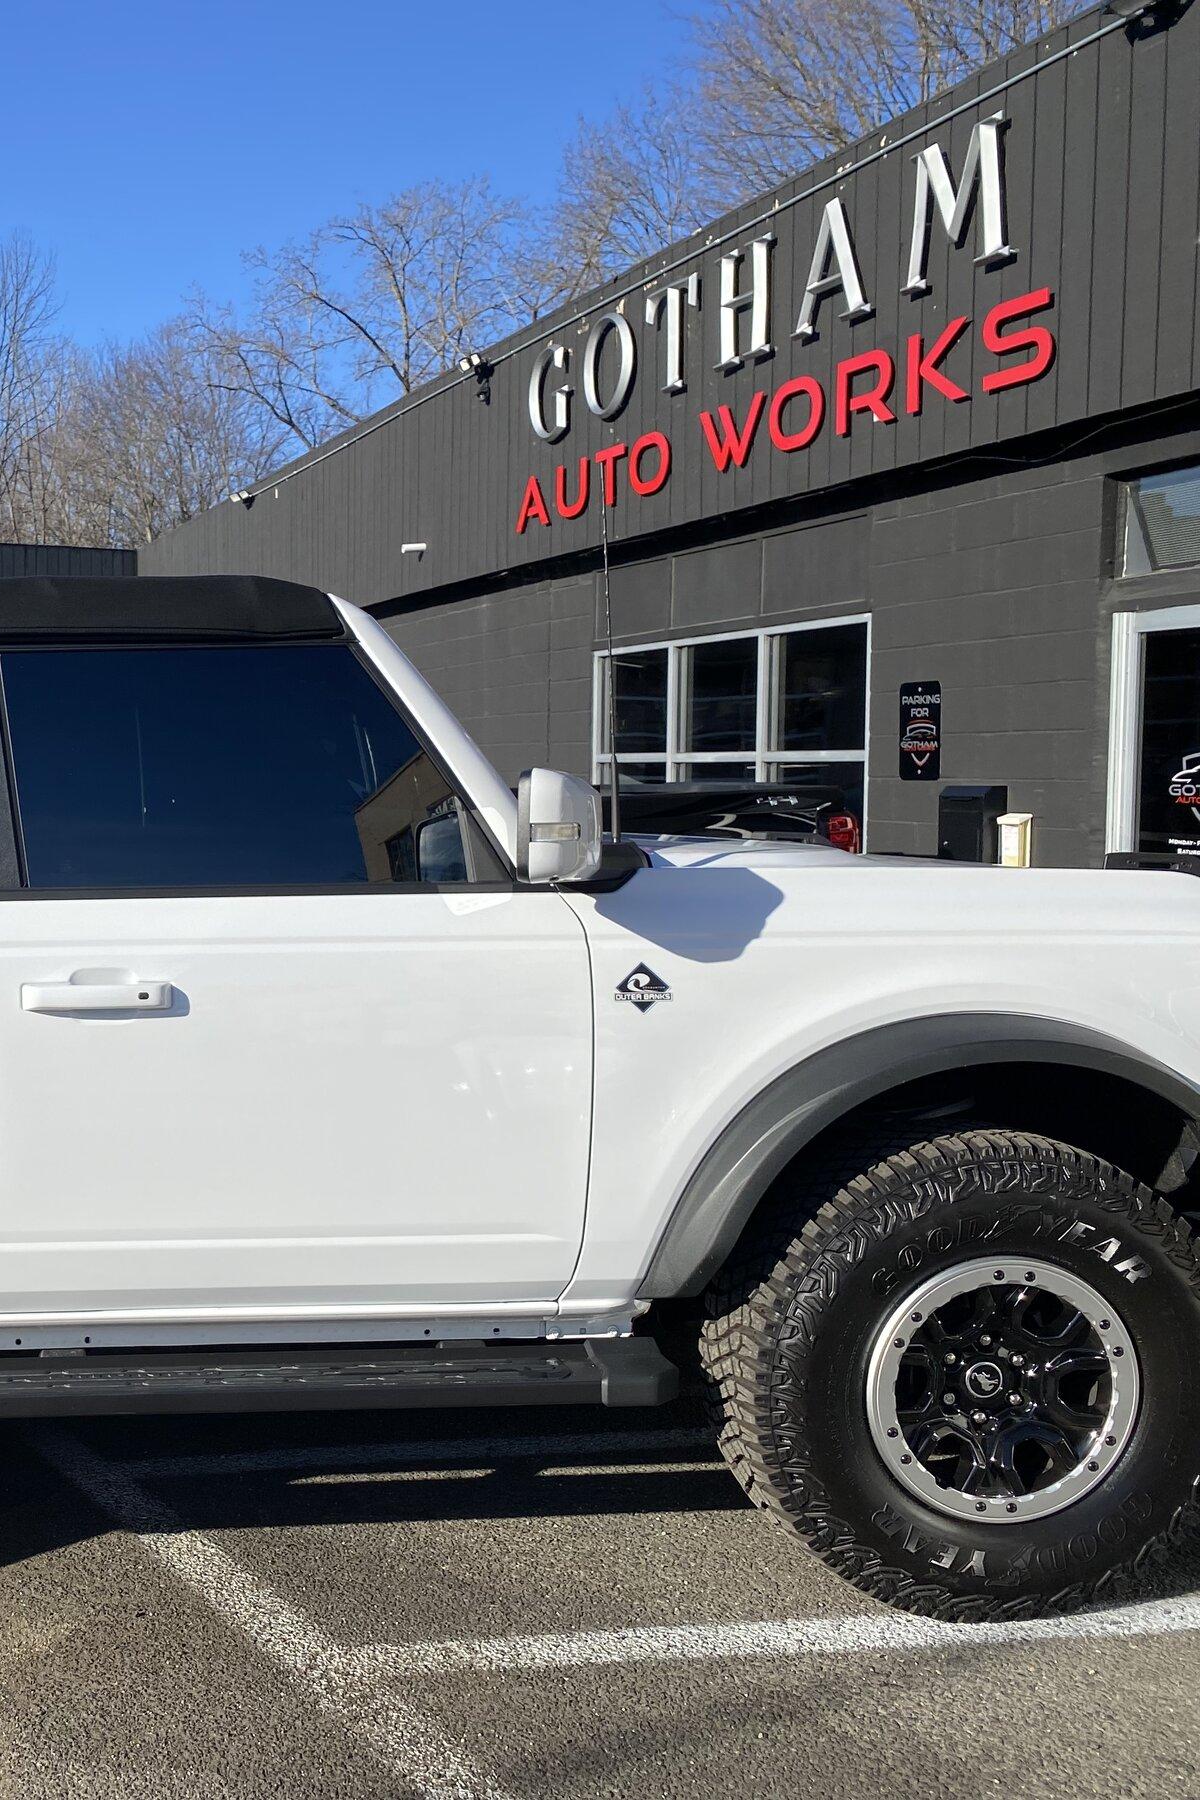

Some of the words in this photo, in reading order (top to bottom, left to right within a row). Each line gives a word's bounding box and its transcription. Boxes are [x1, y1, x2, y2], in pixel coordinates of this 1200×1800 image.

[528, 110, 1017, 443] GOTHAM
[516, 431, 670, 533] AUTO
[700, 287, 1055, 472] WORKS
[902, 694, 940, 706] PARKING
[910, 707, 929, 717] FOR
[900, 740, 938, 749] GOTHAM
[615, 993, 642, 1001] OUTER
[643, 993, 671, 1001] BANKS
